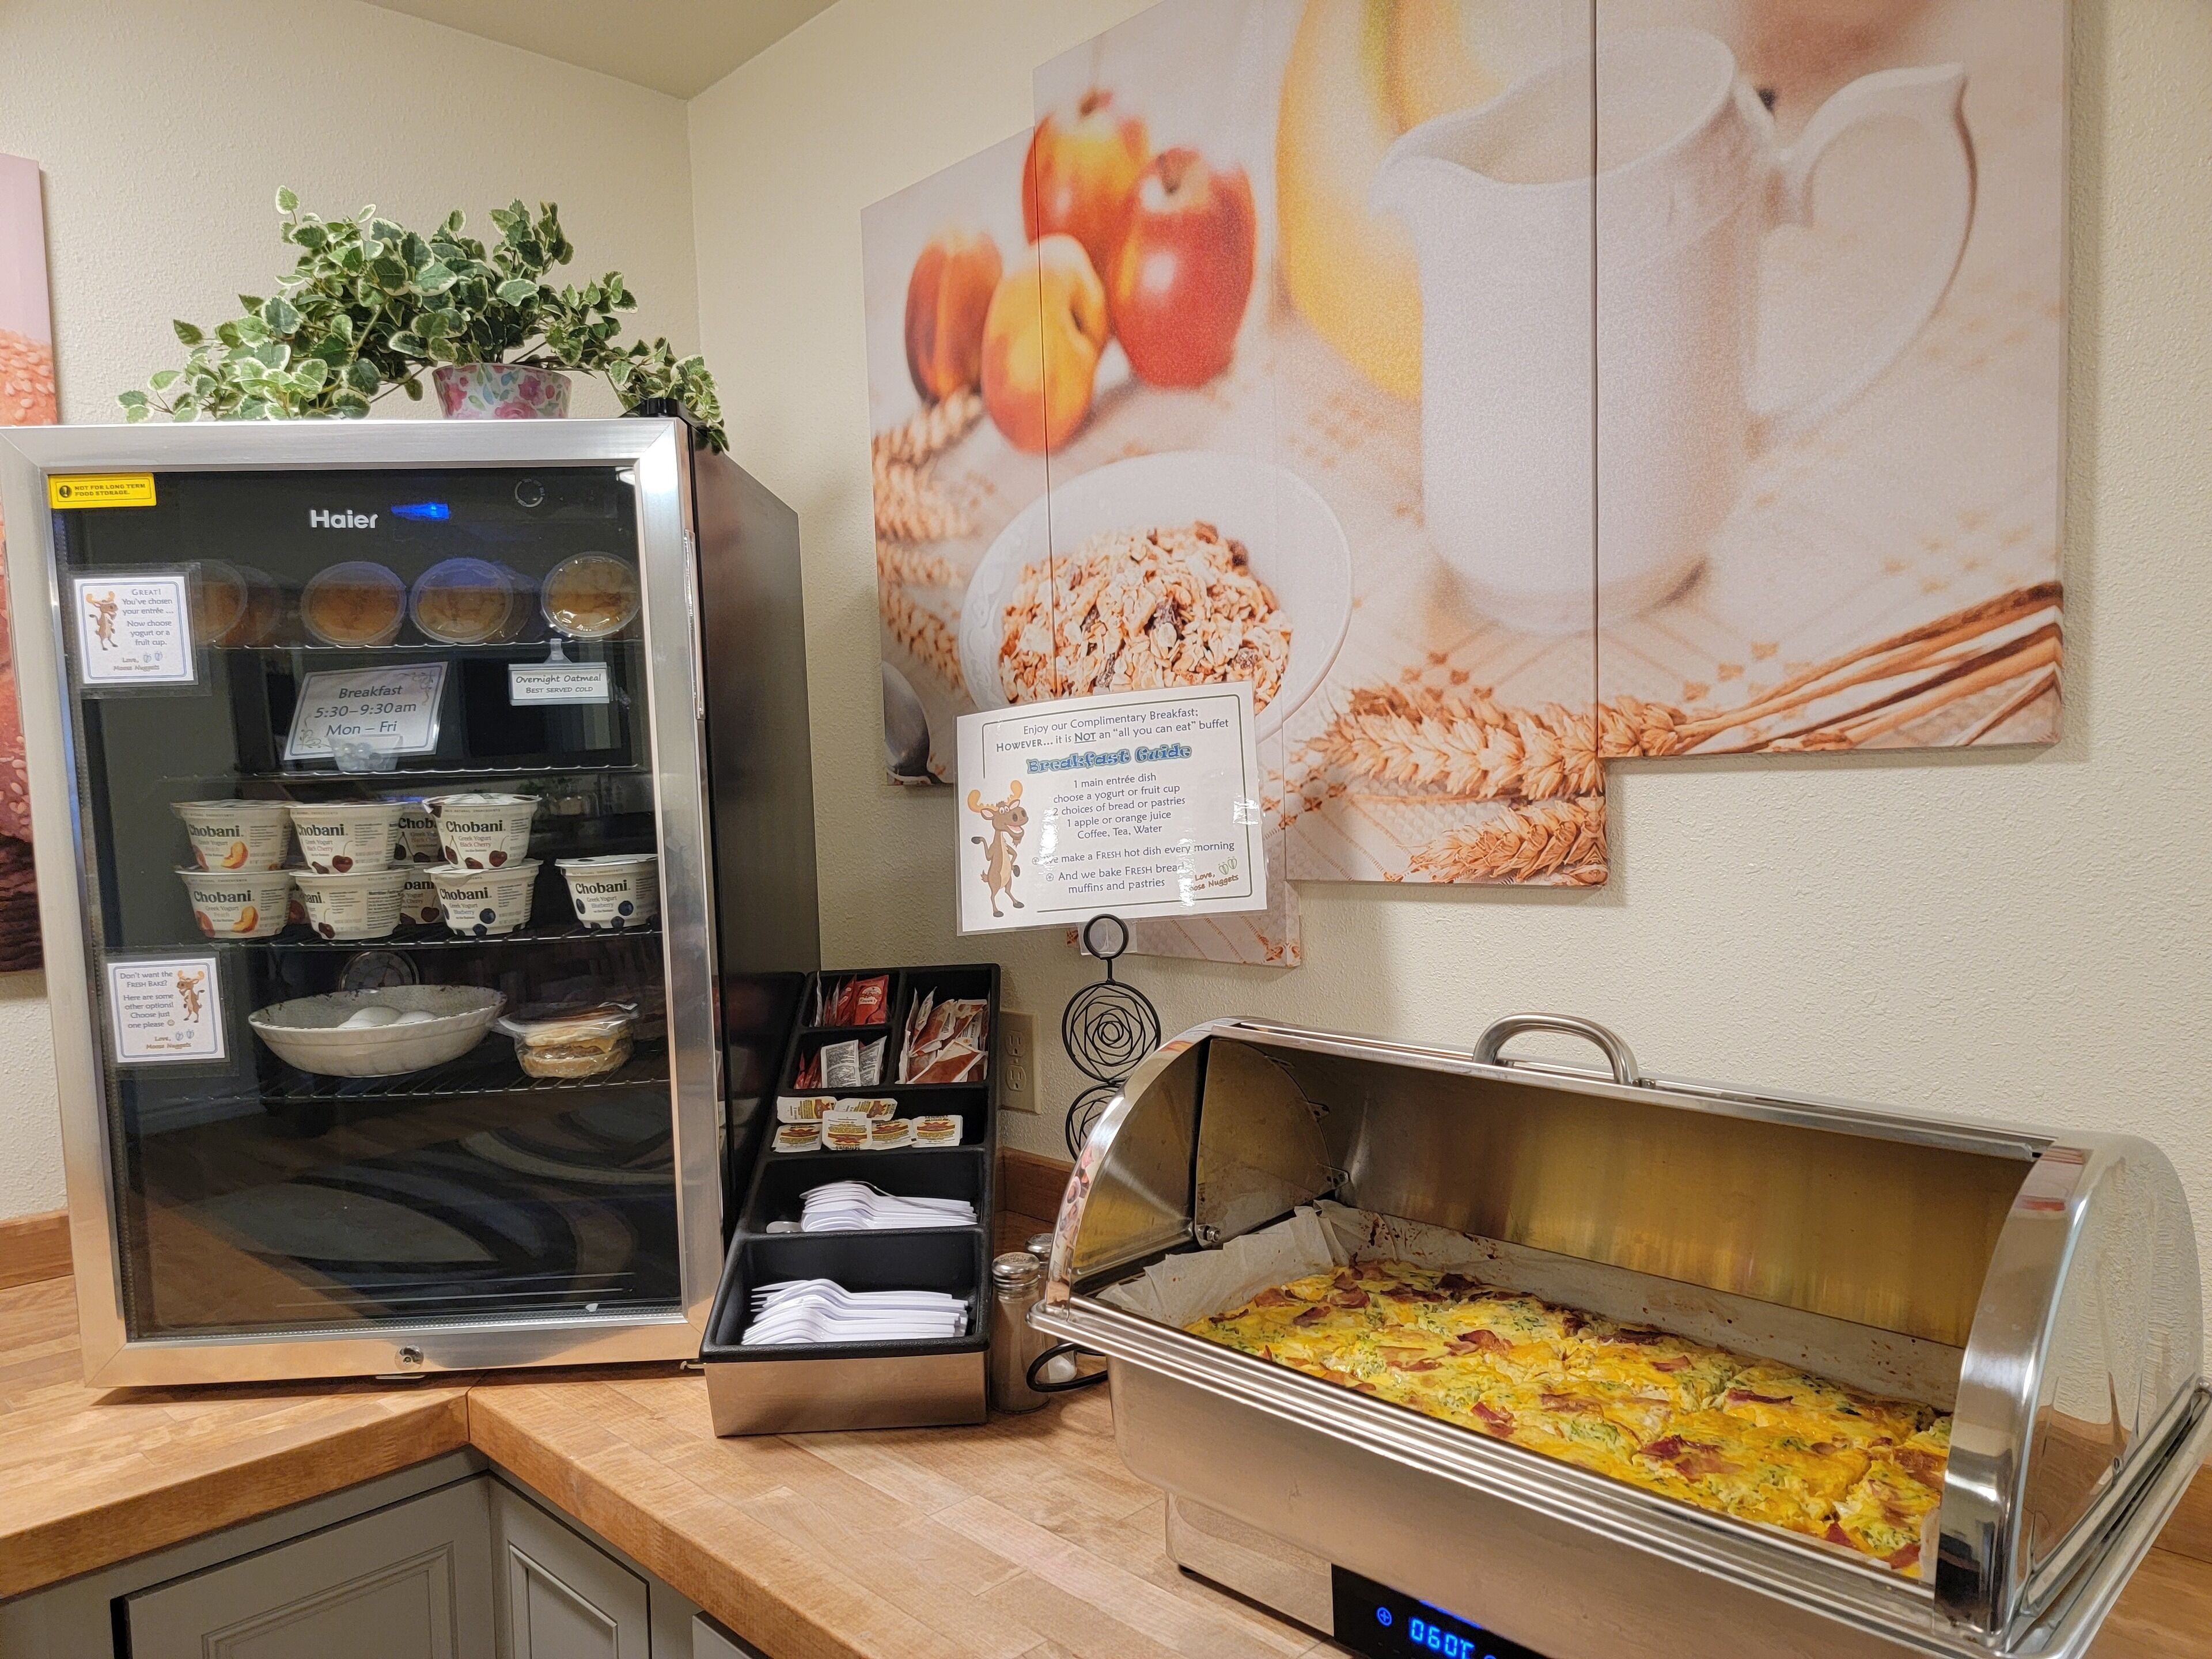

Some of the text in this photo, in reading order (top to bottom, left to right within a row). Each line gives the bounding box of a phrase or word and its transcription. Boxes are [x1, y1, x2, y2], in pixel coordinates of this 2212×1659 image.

[309, 510, 378, 529] Haier
[516, 673, 601, 685] Overnight Oatmeal
[339, 684, 401, 699] Breakfast
[326, 722, 361, 736] Mon
[380, 721, 396, 734] Fri
[1024, 726, 1048, 735] Enjoy
[1070, 714, 1146, 729] Complimentary
[1065, 734, 1071, 743] is
[1074, 733, 1096, 743] NOT
[1133, 729, 1152, 737] you
[1199, 719, 1229, 729] buffet
[1026, 743, 1191, 774] Breakfast Guide
[1081, 778, 1103, 787] main
[1107, 775, 1135, 785] entrée
[1138, 773, 1156, 782] dish
[1054, 793, 1084, 803] choose
[1095, 789, 1124, 801] yogurt
[1141, 786, 1160, 794] fruit
[1164, 785, 1180, 794] cup
[1062, 805, 1093, 815] choices
[1096, 804, 1106, 812] of
[1108, 801, 1134, 810] bread
[1152, 797, 1185, 808] pastries
[446, 820, 503, 832] Chobani
[1067, 819, 1071, 827] 1
[1074, 817, 1099, 828] apple
[1115, 813, 1147, 824] orange
[1150, 812, 1171, 821] juice
[188, 825, 240, 837] Chobani
[1078, 825, 1162, 839] Coffee, Tea, Water
[1062, 854, 1085, 862] make
[1097, 851, 1121, 859] FRESH
[1124, 849, 1140, 857] hot
[1143, 847, 1161, 855] dish
[1165, 846, 1190, 854] every
[1194, 842, 1234, 851] morning
[1058, 871, 1077, 881] And
[1099, 868, 1122, 877] bake
[1125, 866, 1152, 875] FRESH
[1195, 872, 1215, 881] Love,
[1209, 874, 1238, 887] Nuggets
[575, 880, 627, 894] Chobani
[1069, 879, 1165, 893] muffins and pastries
[194, 890, 252, 903] Chobani
[440, 887, 488, 900] Chobani
